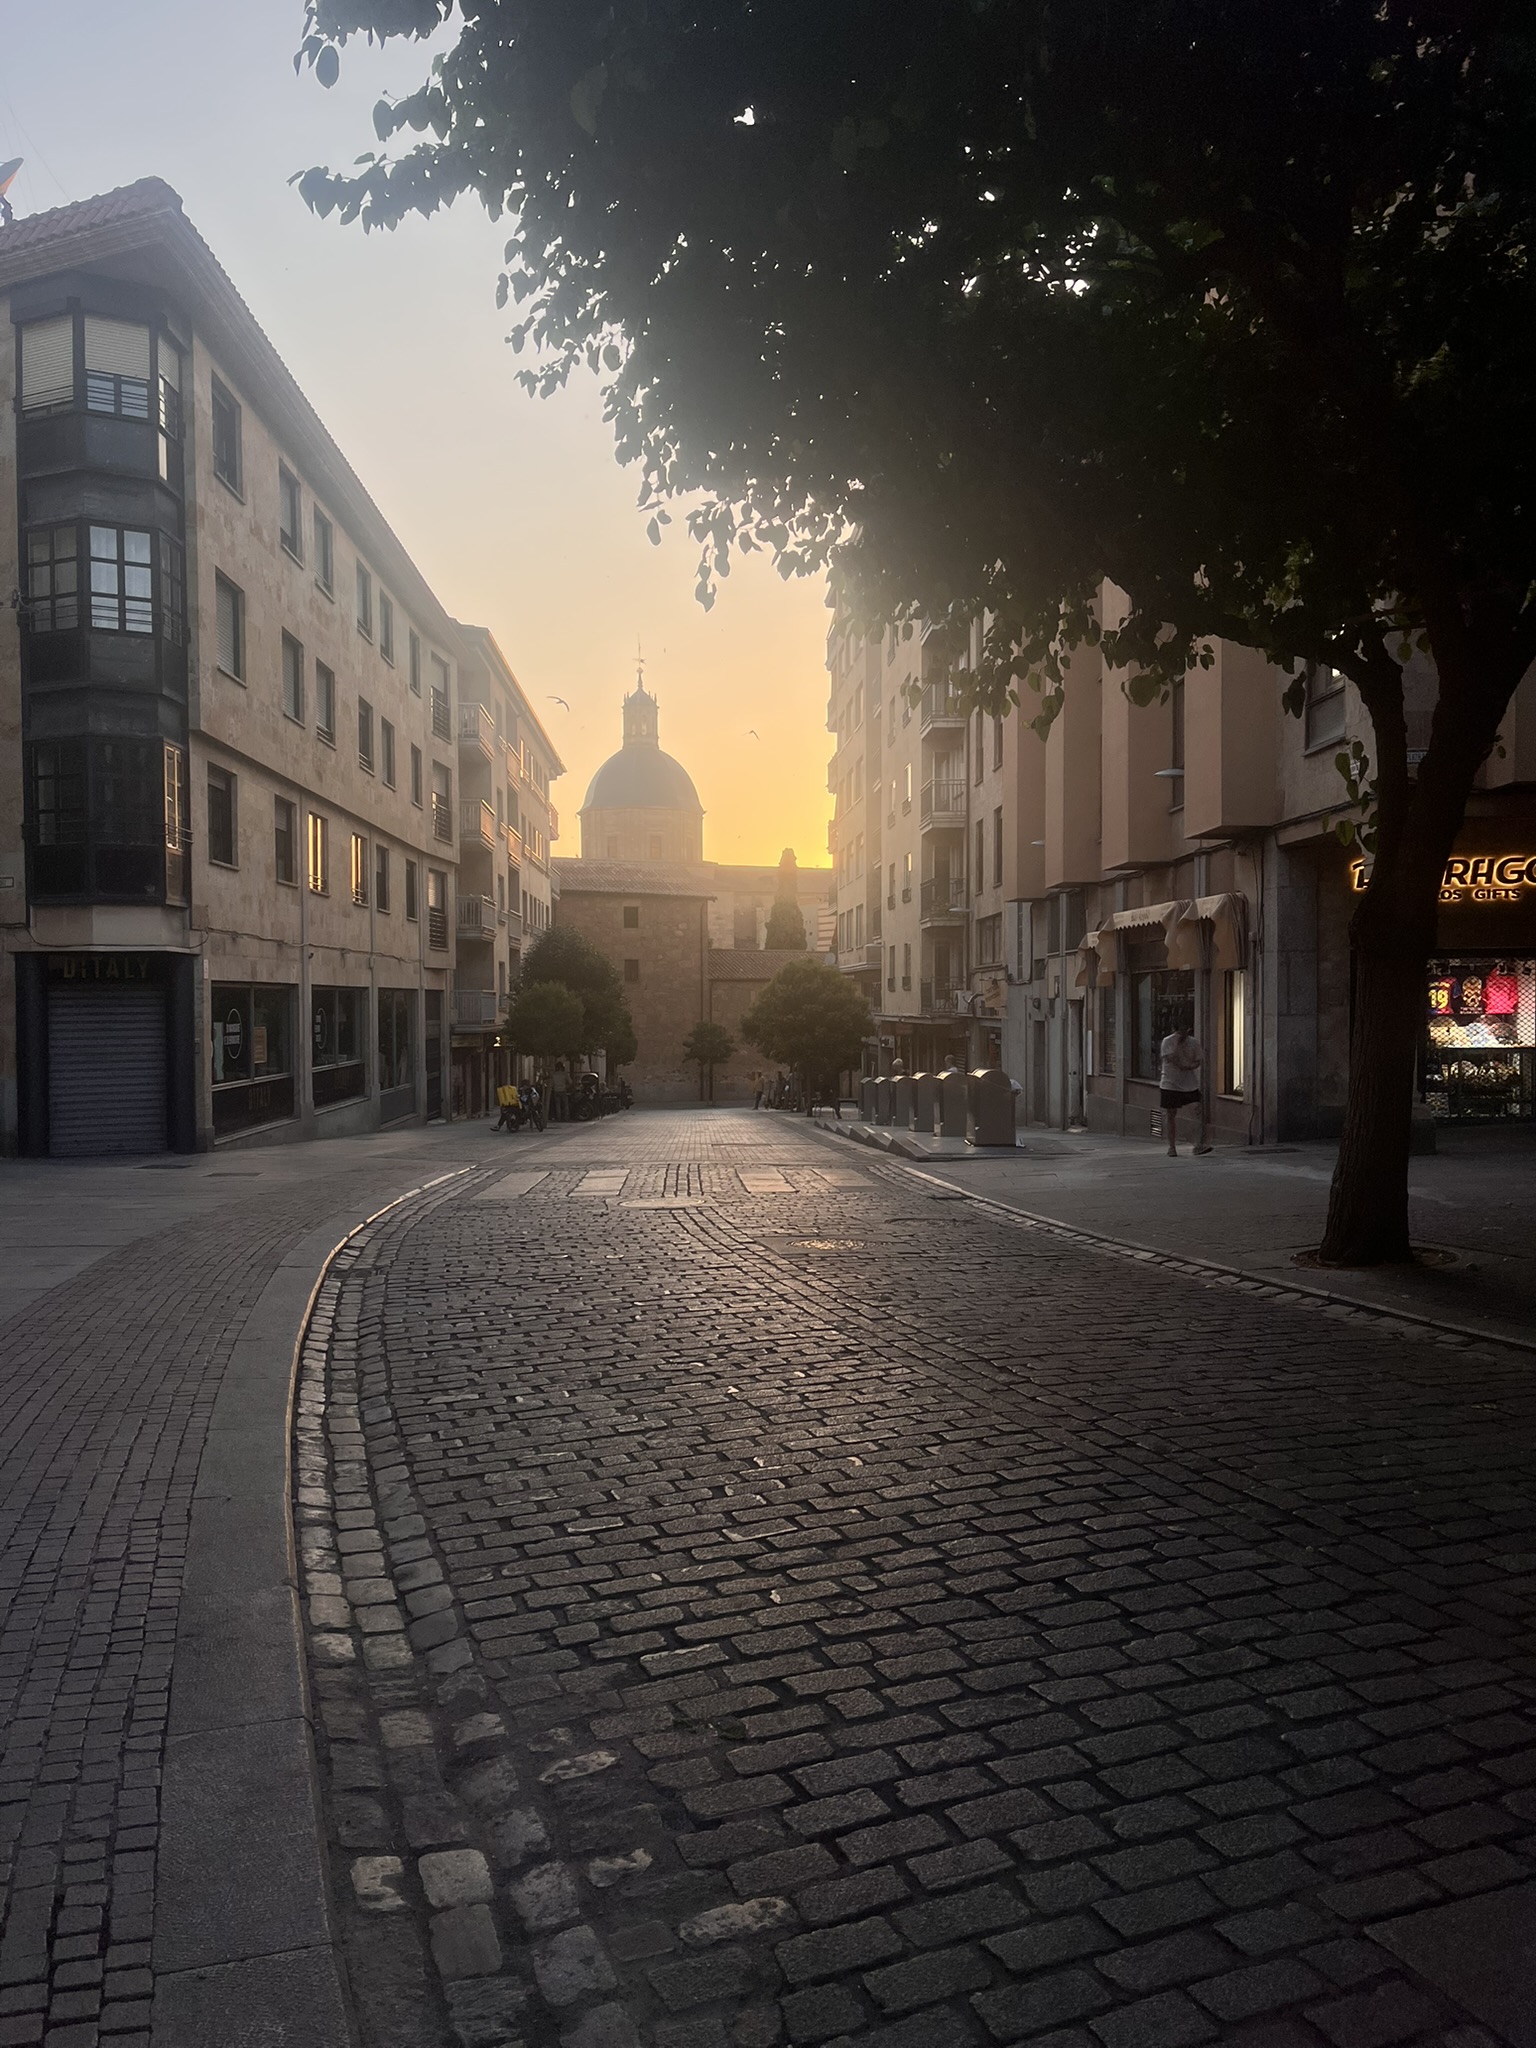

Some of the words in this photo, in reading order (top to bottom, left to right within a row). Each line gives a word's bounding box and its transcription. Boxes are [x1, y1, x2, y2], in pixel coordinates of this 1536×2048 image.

[1438, 888, 1463, 901] OS
[1474, 888, 1521, 901] GIFTS
[1428, 988, 1449, 1009] 19
